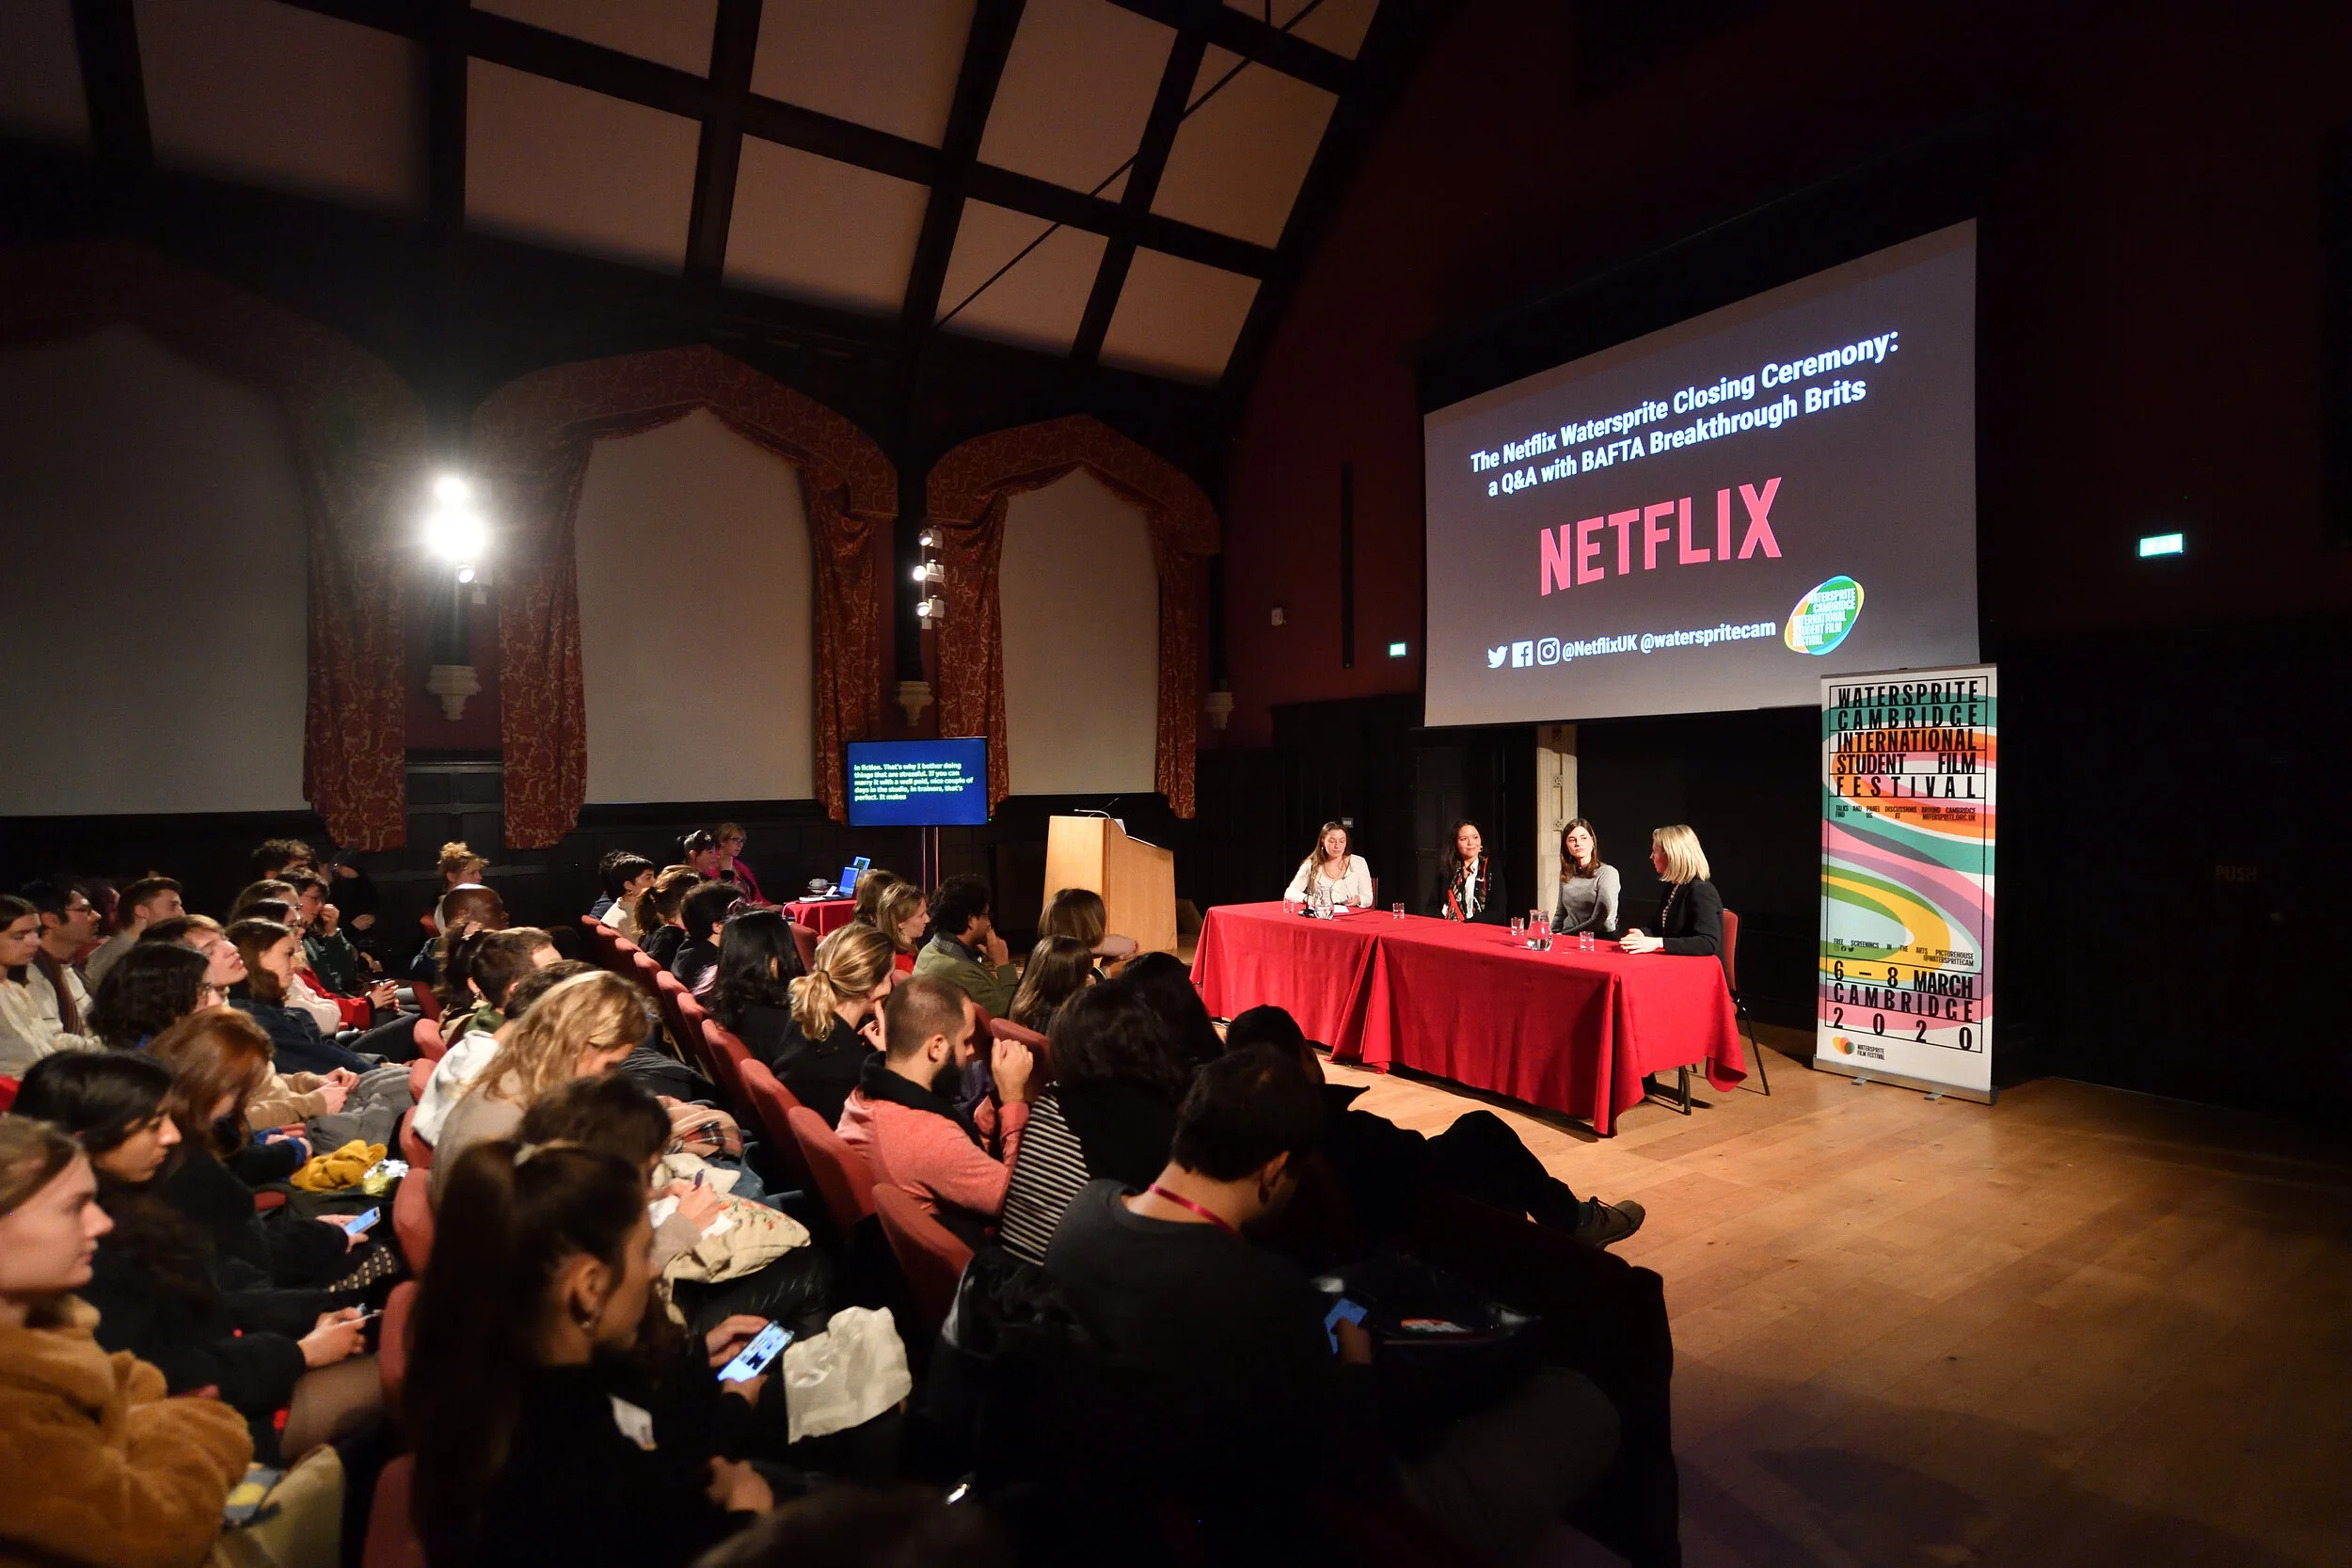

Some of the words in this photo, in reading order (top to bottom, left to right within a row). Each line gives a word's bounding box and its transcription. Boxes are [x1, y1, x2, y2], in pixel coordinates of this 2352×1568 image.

[1470, 451, 1500, 472] The
[1503, 432, 1557, 464] Netflix
[1560, 401, 1668, 447] Watersprite
[1673, 374, 1756, 414] Closing
[1761, 331, 1899, 388] Ceremony:
[1488, 481, 1498, 497] a
[1502, 467, 1538, 495] Q&A
[1541, 454, 1578, 483] with
[1581, 436, 1645, 472] BAFTA
[1650, 394, 1798, 454] Breakthrough
[1804, 379, 1867, 414] Brits
[1540, 477, 1783, 596] NETFLIX
[1562, 634, 1638, 662] @NetflixUK
[1640, 621, 1776, 654] @waterspritecam
[1838, 680, 1979, 708] WATERSPRITE
[1837, 704, 1978, 730] CAMBRIDGE
[1836, 728, 1977, 752] INTERNATIONAL
[1836, 752, 1906, 774] STUDENT
[1937, 752, 1977, 774] FILM
[1836, 776, 1976, 798] FESTIVAL
[2216, 864, 2258, 881] PUSH
[1851, 940, 1879, 949] SCREENINGS
[1915, 946, 1928, 955] ARTS
[1935, 949, 1974, 959] PICTUREHOUSE
[1834, 960, 1844, 981] 6
[1887, 967, 1899, 988] 8
[1914, 970, 1973, 999] MARCH
[1834, 982, 1973, 1022] CAMBRIDGE
